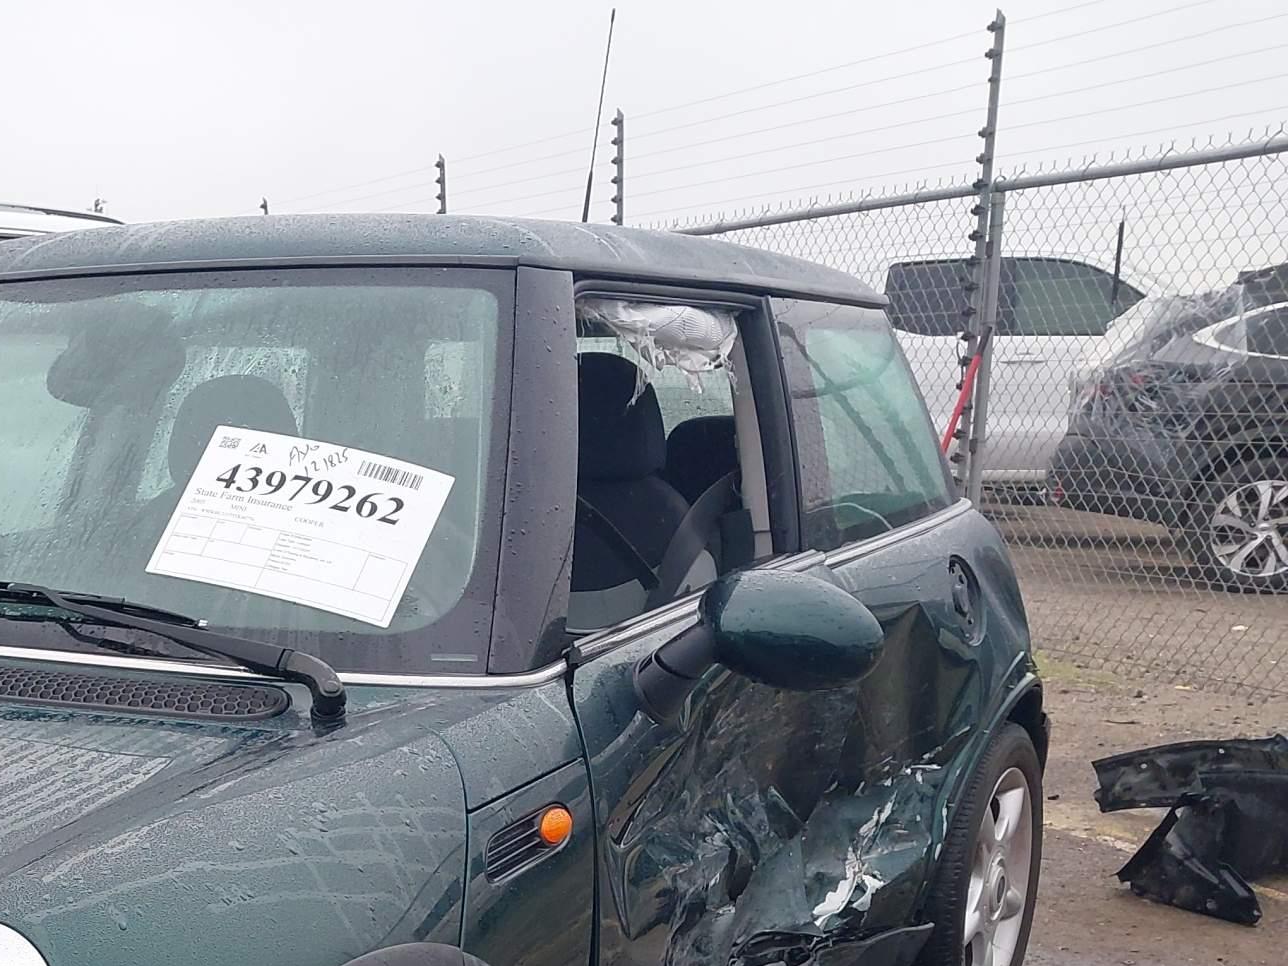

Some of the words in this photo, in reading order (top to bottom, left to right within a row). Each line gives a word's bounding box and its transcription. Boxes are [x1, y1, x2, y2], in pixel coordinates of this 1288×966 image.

[195, 488, 218, 498] State
[220, 491, 245, 502] Farm
[247, 495, 294, 512] Insurance
[216, 463, 405, 525] 43979262
